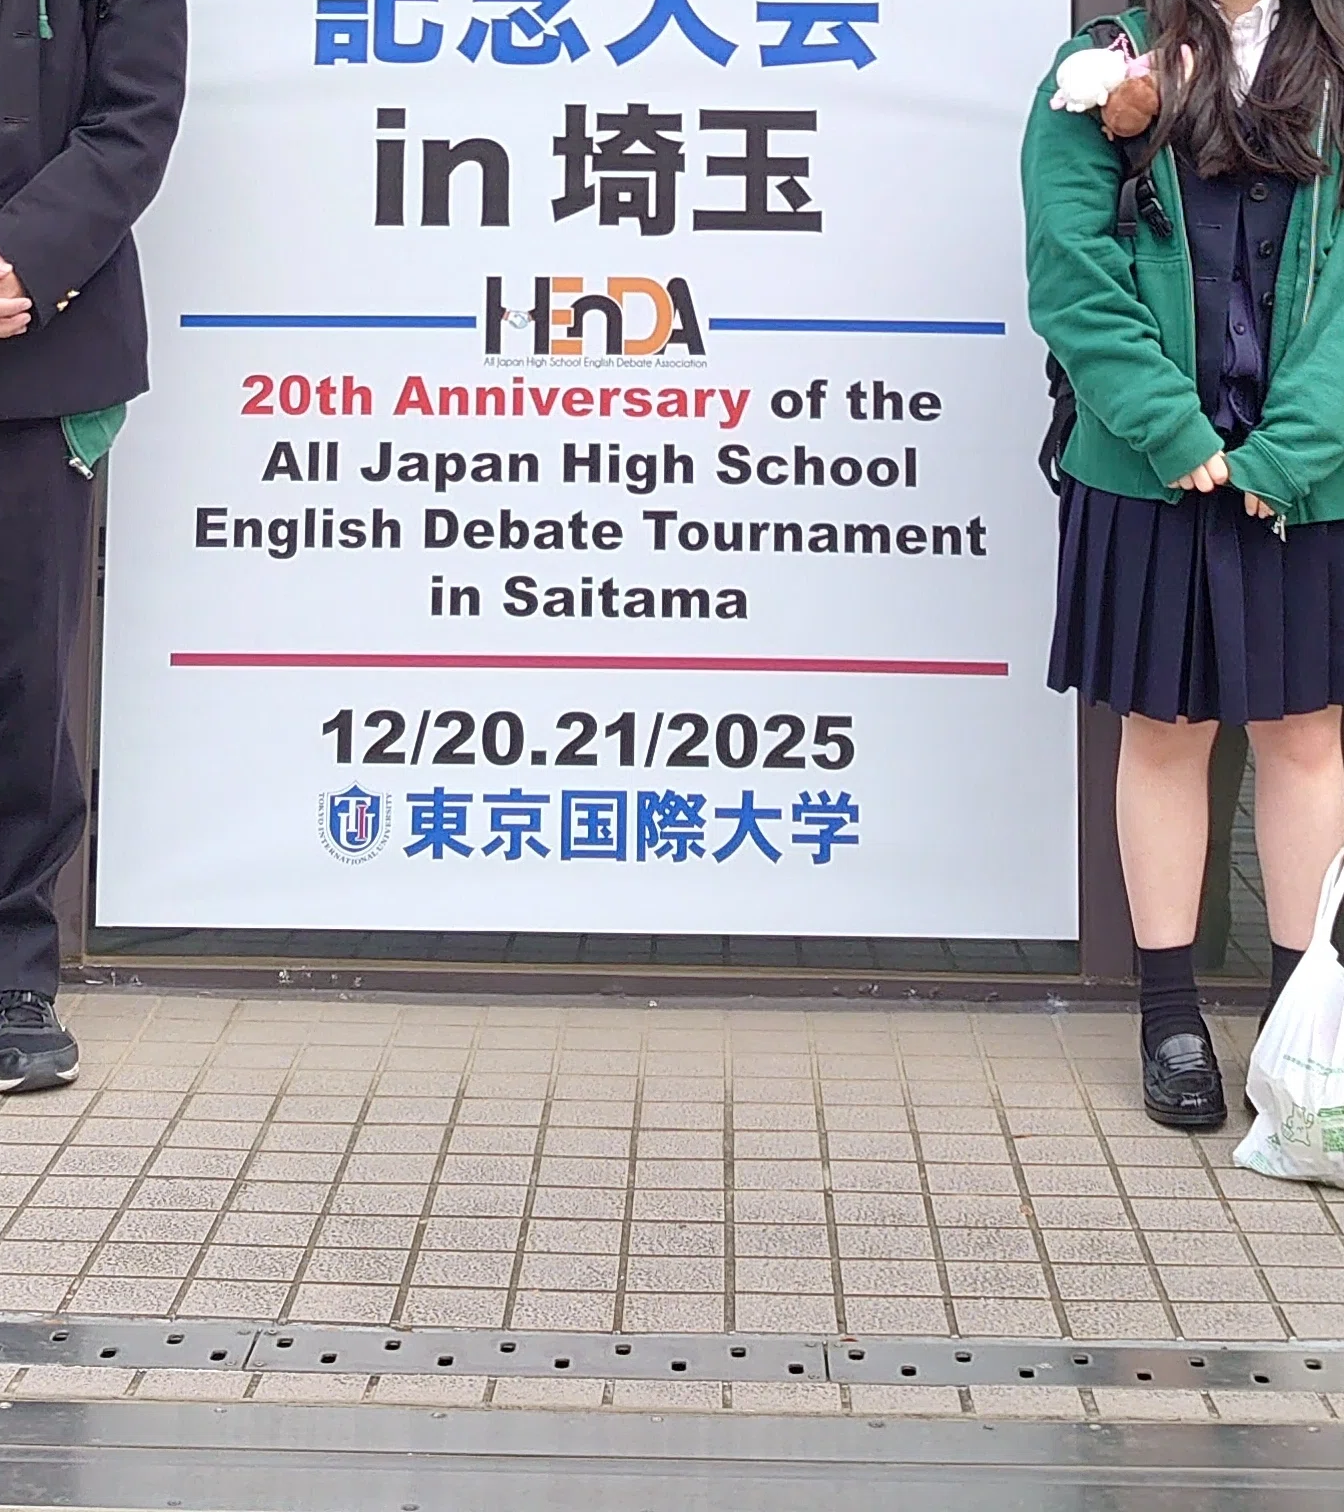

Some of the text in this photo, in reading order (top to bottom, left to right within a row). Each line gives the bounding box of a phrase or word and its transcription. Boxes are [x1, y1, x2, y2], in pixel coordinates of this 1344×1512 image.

[375, 103, 822, 236] in 埼玉
[484, 356, 708, 369] All Japan High School English Debate Association
[241, 375, 941, 429] 20th Anniversary of the
[262, 442, 916, 494] All Japan High School
[196, 508, 986, 559] English Debate Tournament
[432, 576, 747, 619] in Saitama
[323, 709, 854, 770] 12/20.21/2025
[403, 787, 859, 864] 東京国際大学
